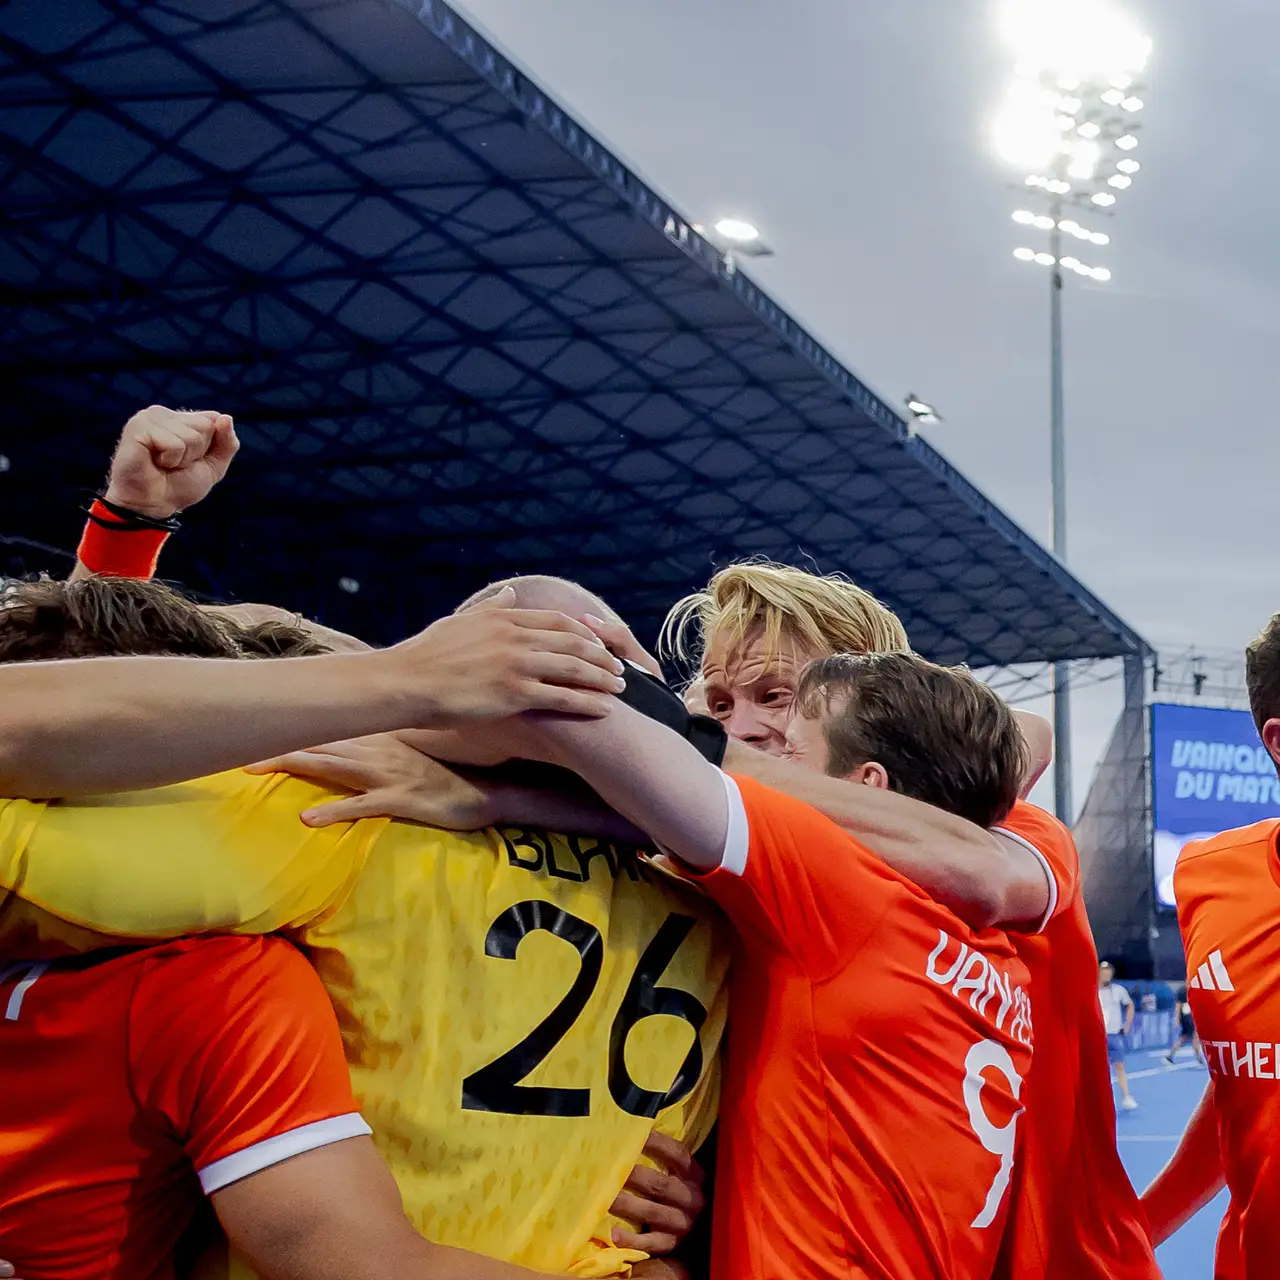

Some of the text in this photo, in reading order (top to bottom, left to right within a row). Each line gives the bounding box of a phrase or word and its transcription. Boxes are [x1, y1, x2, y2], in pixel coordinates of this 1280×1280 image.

[1171, 740, 1278, 776] VAINQU
[1175, 770, 1214, 800] DU
[462, 899, 707, 1118] 26
[962, 1038, 1026, 1229] 9
